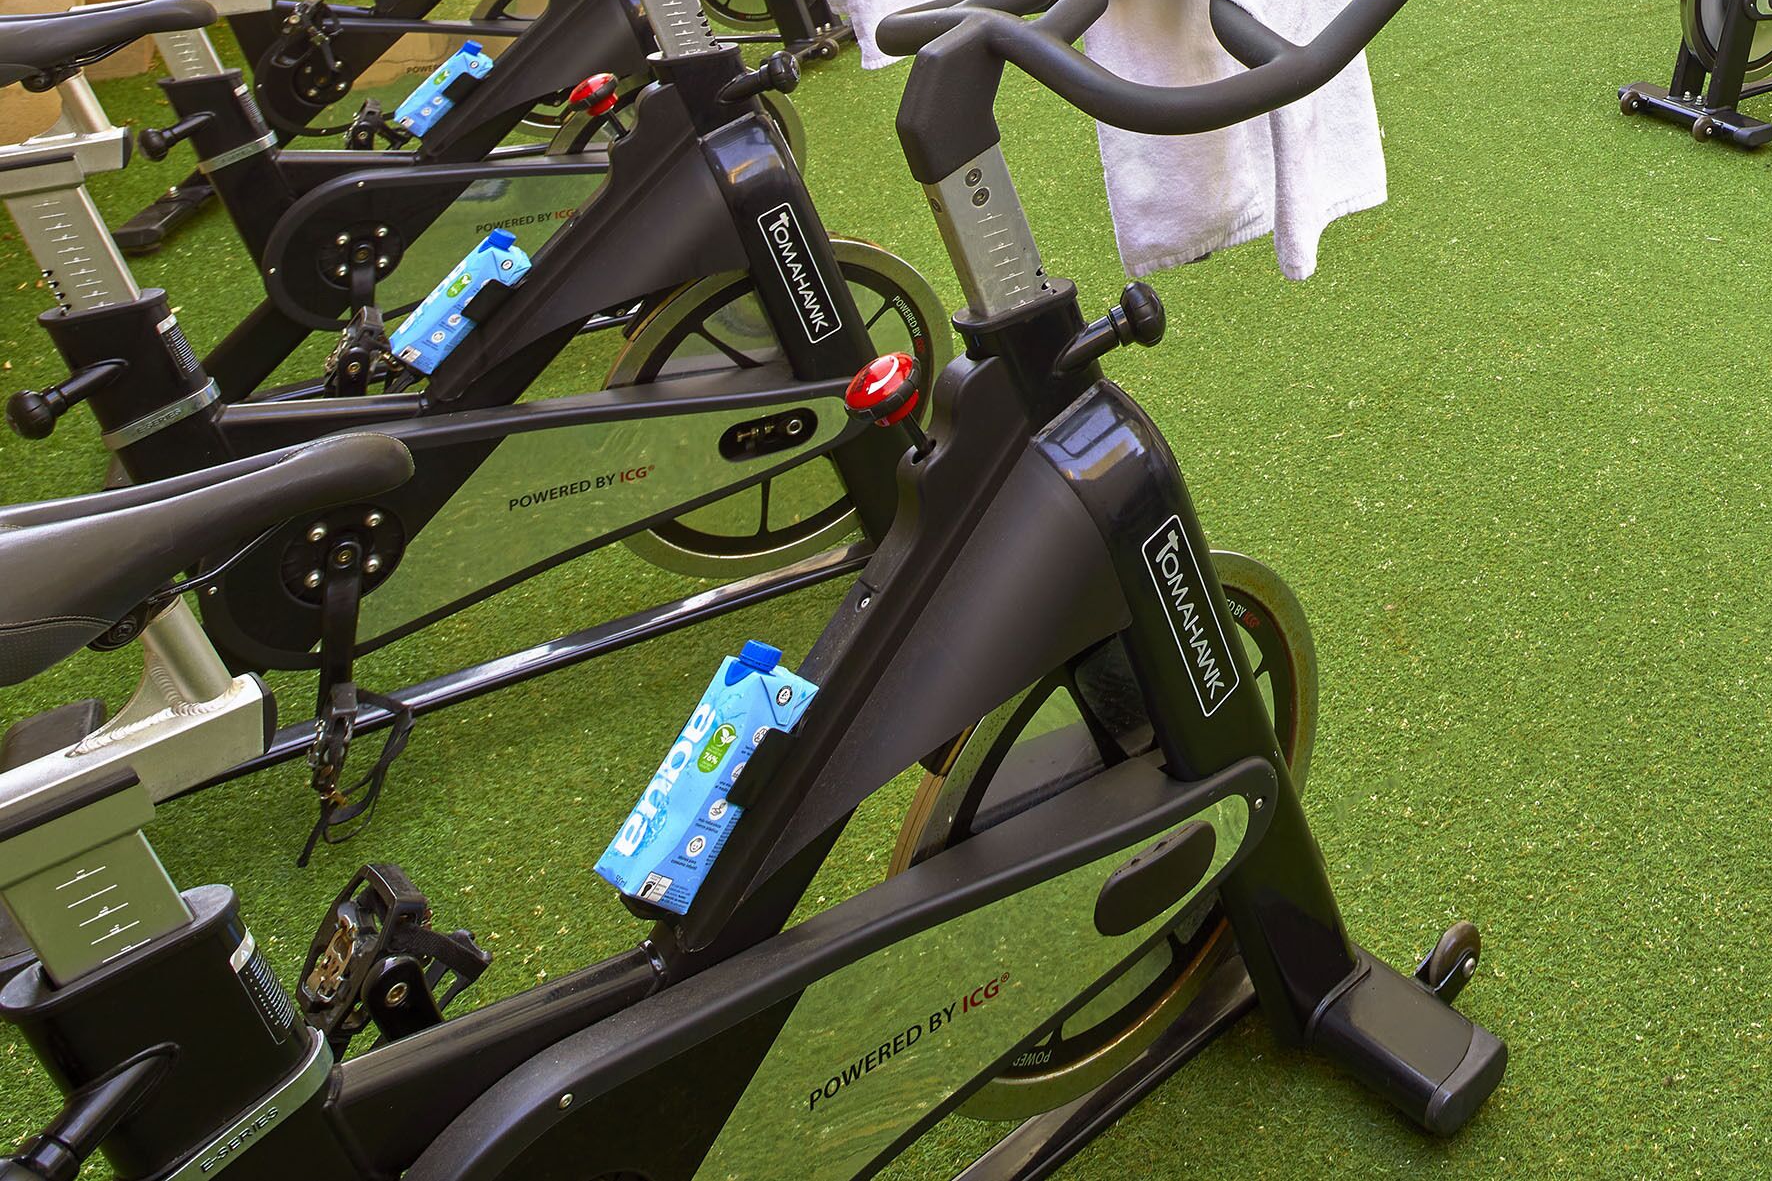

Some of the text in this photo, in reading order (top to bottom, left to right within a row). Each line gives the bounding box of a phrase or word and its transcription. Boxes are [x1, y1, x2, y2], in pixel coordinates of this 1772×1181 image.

[476, 214, 535, 234] POWERED
[537, 211, 552, 223] BY
[769, 212, 829, 333] TOMAHAWK
[891, 295, 918, 329] POWERED
[911, 326, 923, 339] BY
[508, 479, 592, 512] POWERED
[595, 473, 616, 491] BY
[1155, 529, 1226, 701] TOMAHAWK
[1234, 605, 1247, 620] BY
[808, 1024, 923, 1112] POWERED
[929, 1002, 957, 1034] BY
[201, 1106, 279, 1174] E-SERIES
